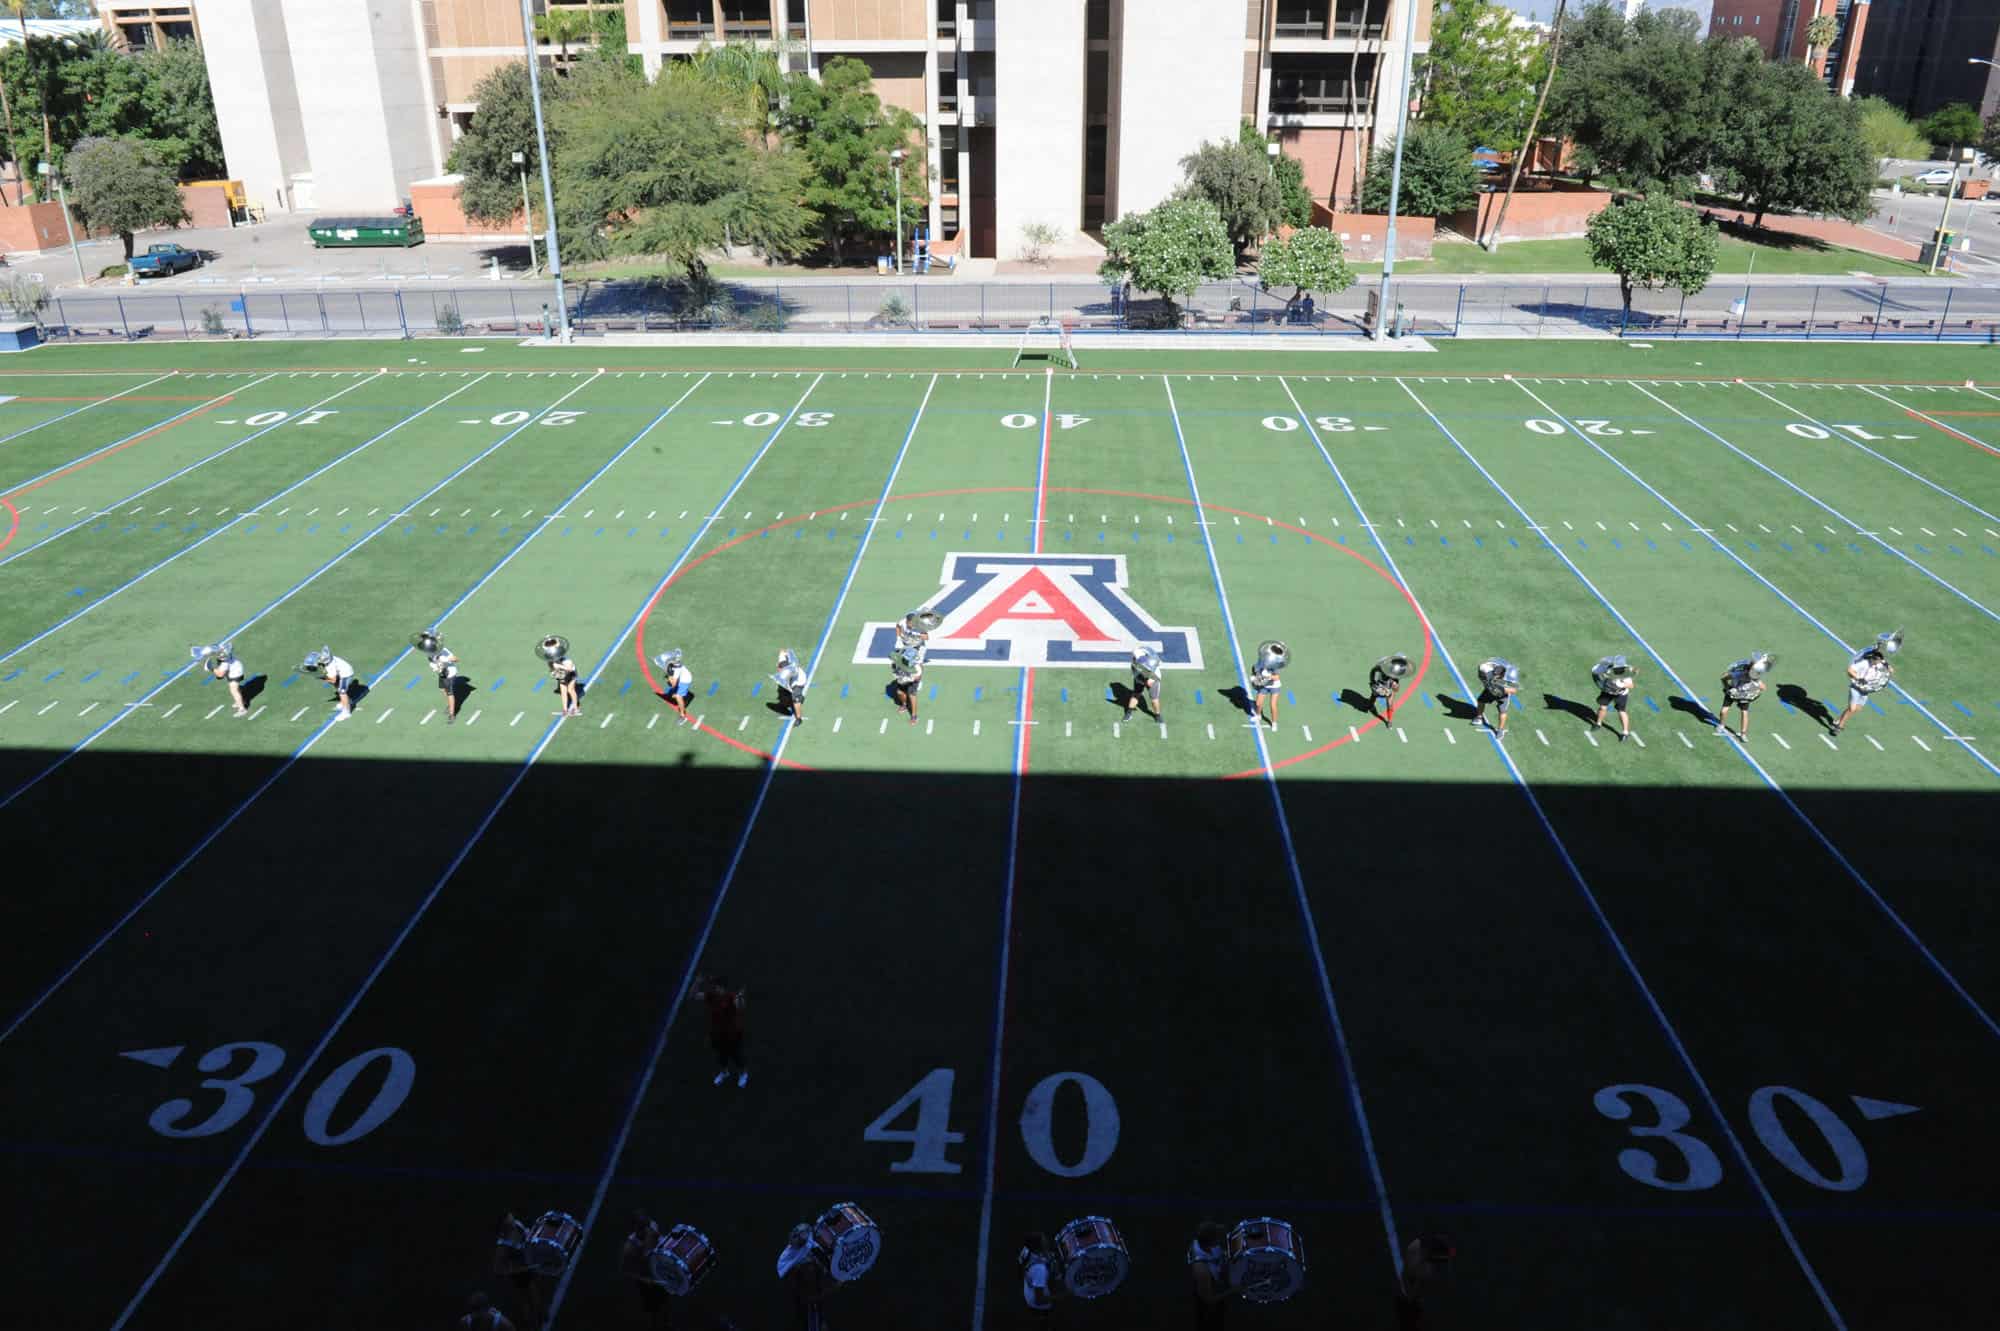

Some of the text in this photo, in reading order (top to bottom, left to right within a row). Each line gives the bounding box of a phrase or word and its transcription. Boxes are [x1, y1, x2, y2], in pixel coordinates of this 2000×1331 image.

[245, 410, 340, 426] 10
[490, 409, 585, 426] 20
[743, 411, 833, 427] 30
[1000, 413, 1093, 429] 40
[1261, 416, 1356, 431] 30
[1524, 419, 1624, 436] 20
[1784, 422, 1885, 440] 10
[852, 552, 1204, 671] A
[147, 1041, 417, 1147] 30
[863, 1066, 1121, 1178] 40
[1593, 1083, 1869, 1192] 30
